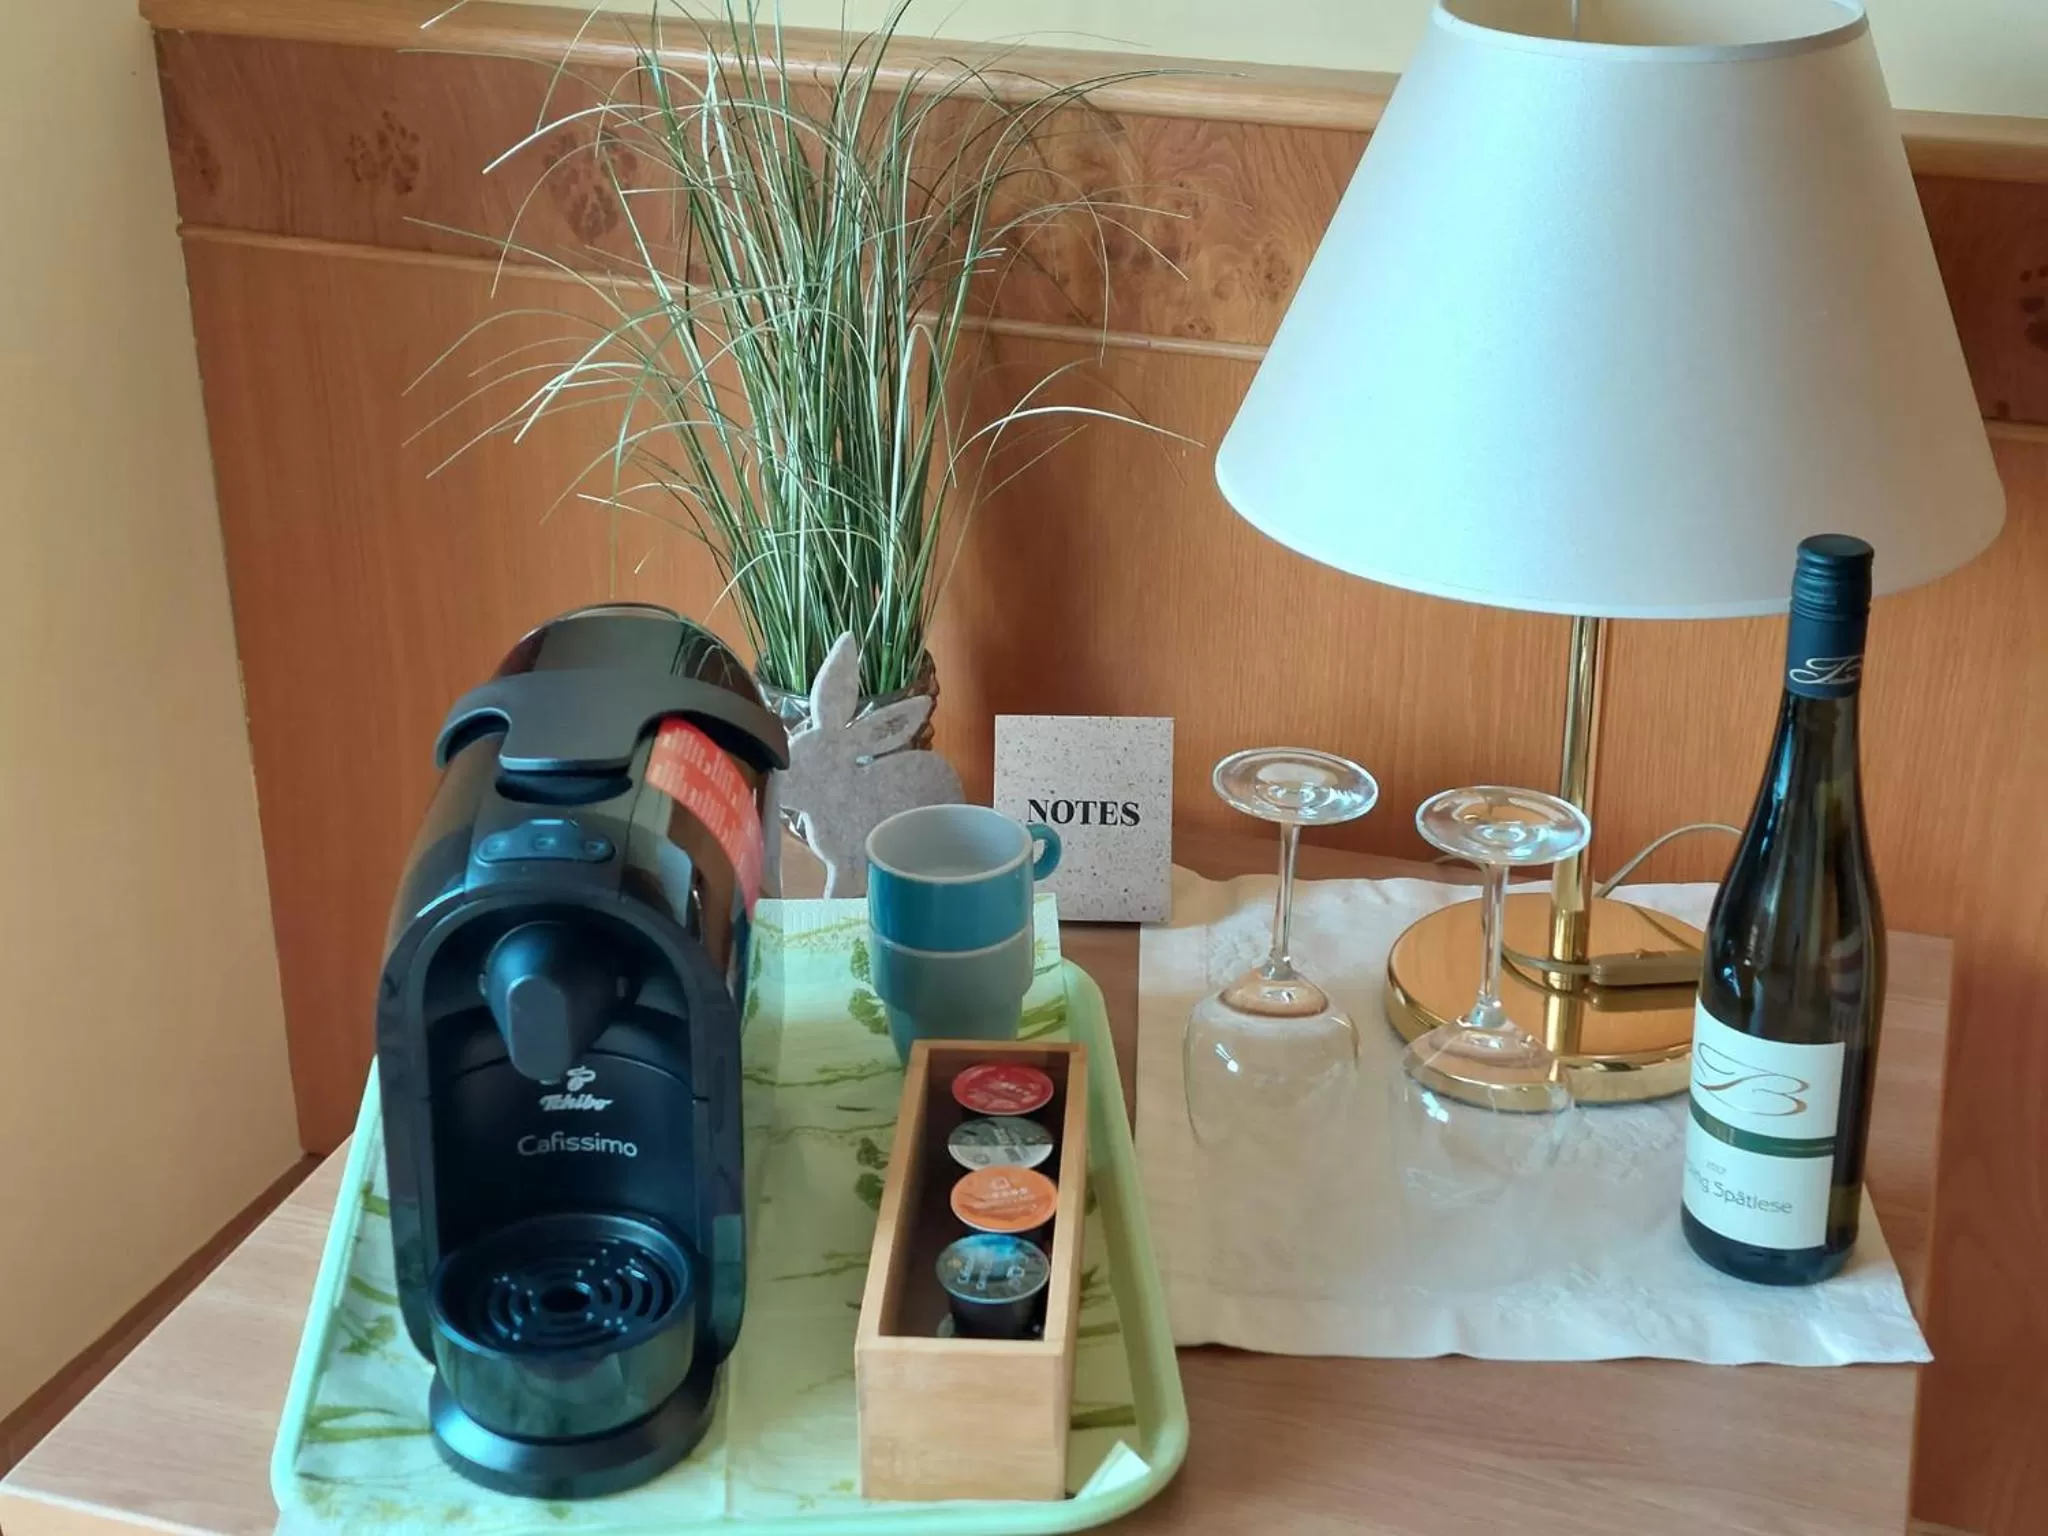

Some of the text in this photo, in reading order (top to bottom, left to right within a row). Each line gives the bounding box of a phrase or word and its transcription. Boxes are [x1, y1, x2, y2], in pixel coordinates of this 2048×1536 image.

[1027, 799, 1141, 826] NOTES
[539, 1094, 614, 1112] Tchibo
[517, 1131, 638, 1157] Cafissimo
